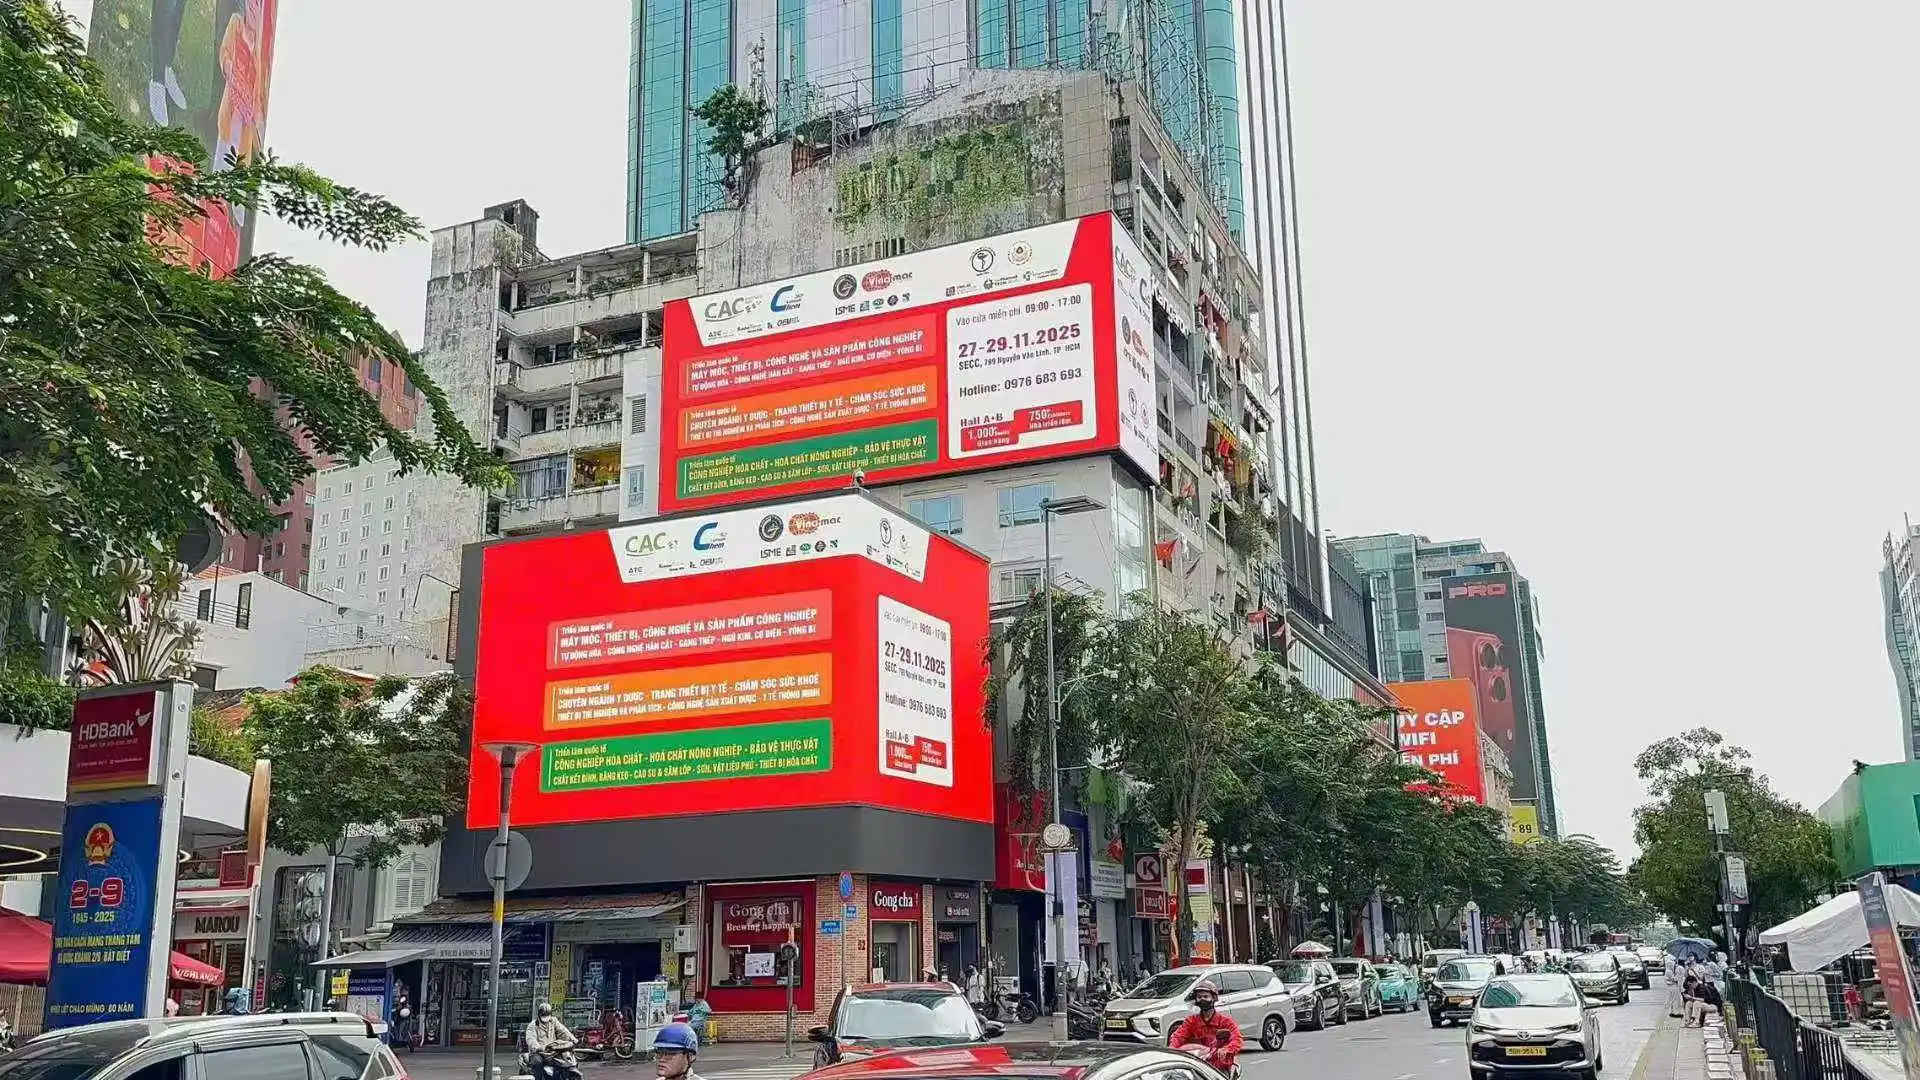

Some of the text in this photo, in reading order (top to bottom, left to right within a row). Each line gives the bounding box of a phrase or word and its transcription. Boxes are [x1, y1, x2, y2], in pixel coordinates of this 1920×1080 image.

[705, 297, 744, 318] CAC
[1026, 300, 1049, 314] 09:00
[1059, 295, 1080, 308] 17:00
[959, 323, 1080, 358] 27-29.11.2025
[960, 358, 982, 370] SECC,
[960, 368, 1081, 397] Hotline: 0976 683 693
[961, 416, 979, 427] Hall
[625, 532, 666, 553] CAC
[561, 634, 579, 647] MÁY
[643, 625, 666, 638] CÔNG
[756, 612, 781, 625] CÔNG
[885, 641, 946, 676] 27-29.11.2025
[1425, 708, 1465, 728] CẬP
[79, 720, 134, 740] HDBank
[554, 759, 574, 771] CÔNG
[1429, 749, 1459, 765] PHÍ
[1519, 824, 1532, 833] 89
[70, 876, 124, 908] 2-9
[874, 890, 898, 912] Gong
[899, 892, 913, 907] cha
[95, 911, 115, 922] 2025
[730, 903, 790, 920] Gong cha
[195, 916, 240, 933] MAROU
[726, 923, 760, 932] Brewing
[556, 945, 567, 955] 97
